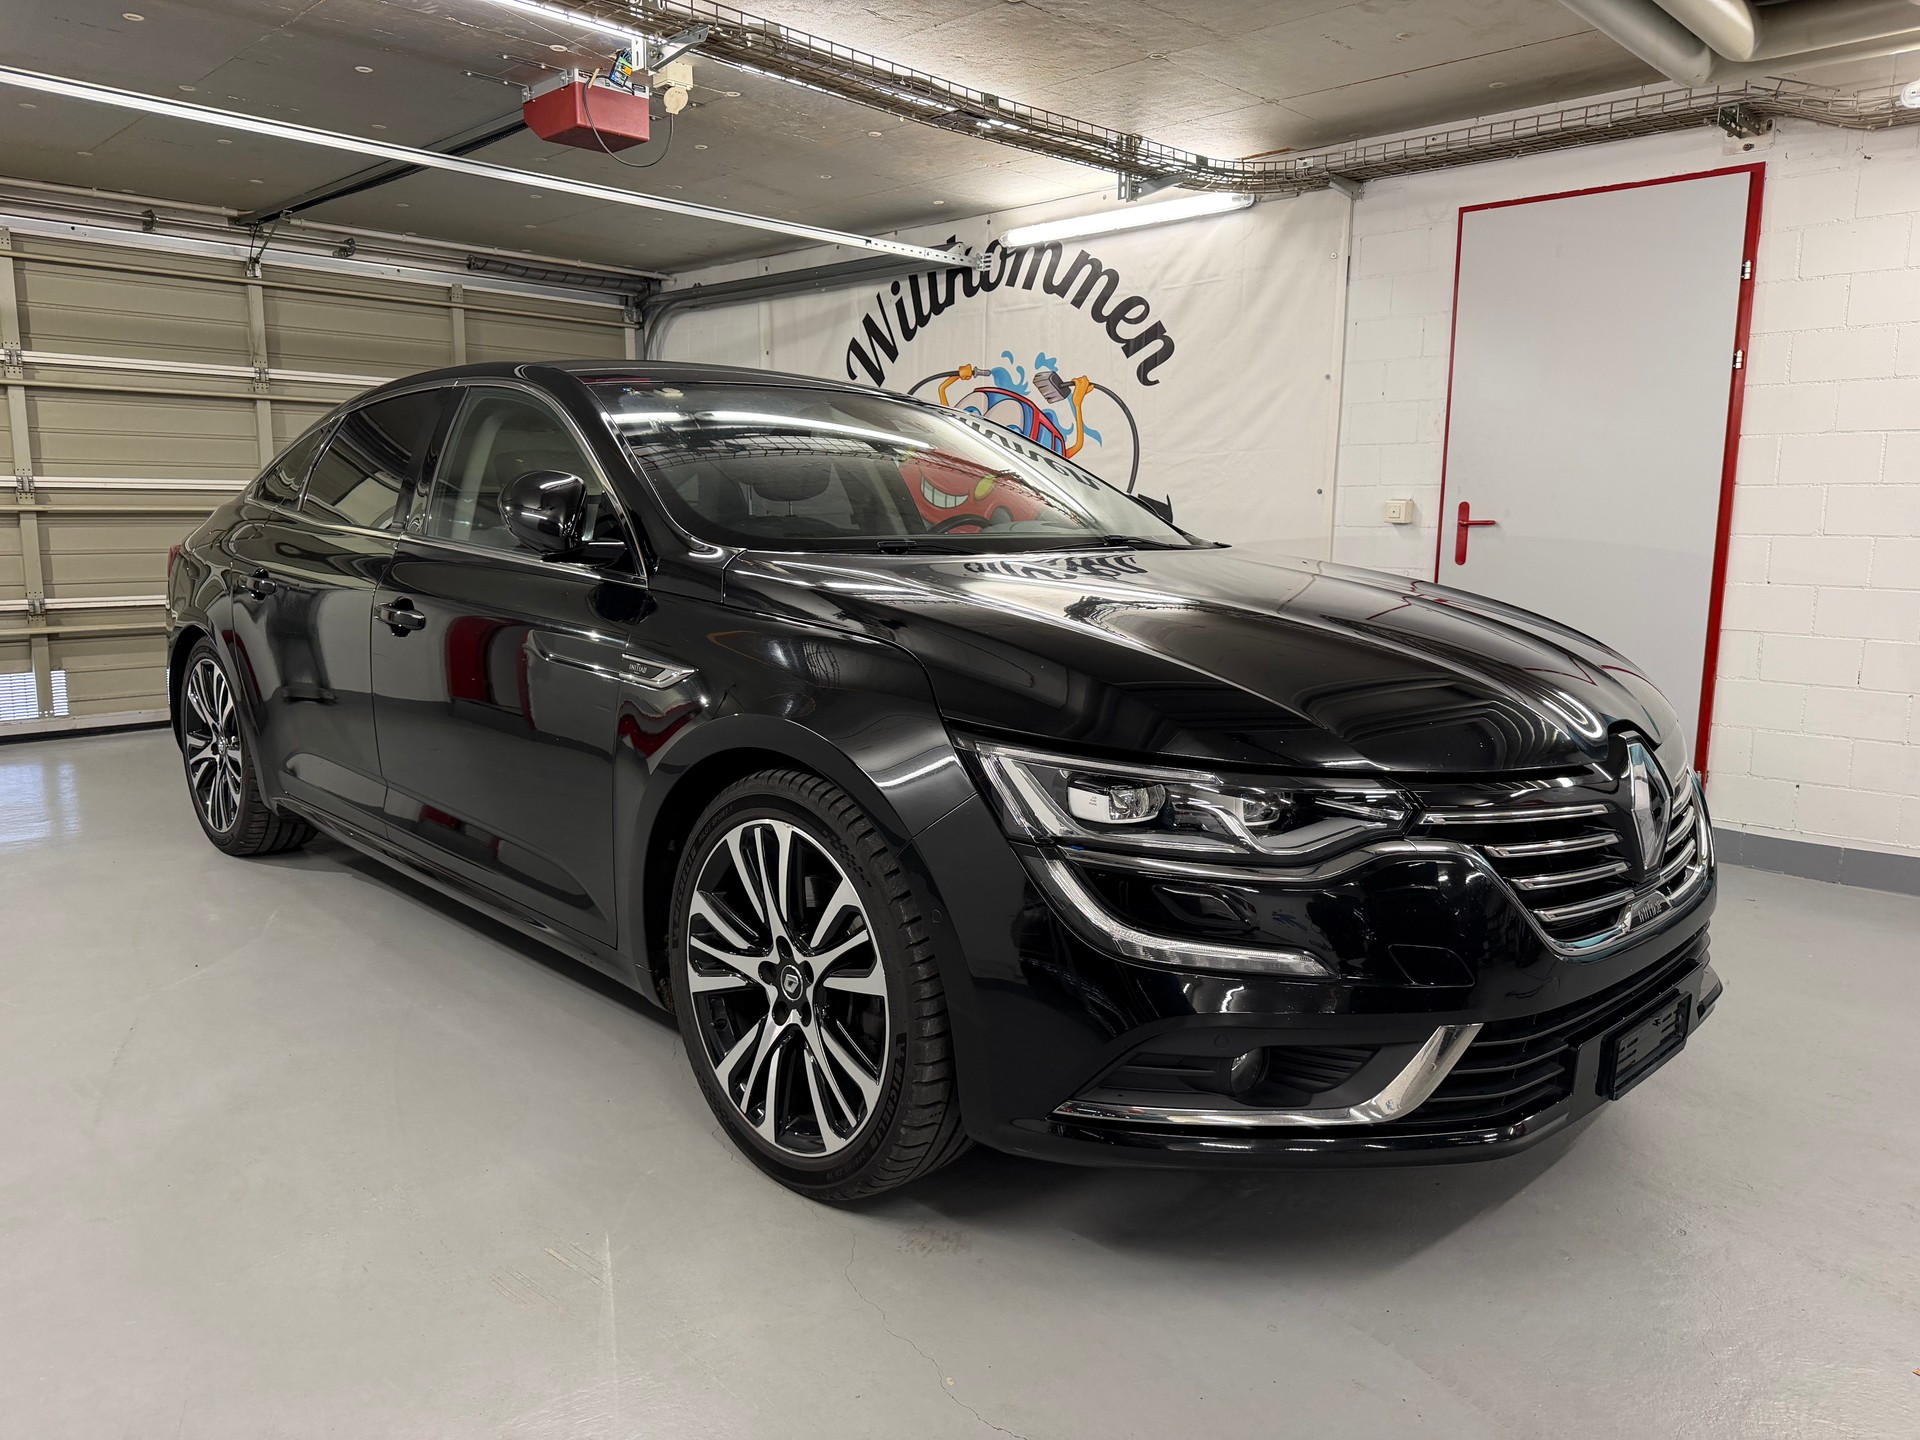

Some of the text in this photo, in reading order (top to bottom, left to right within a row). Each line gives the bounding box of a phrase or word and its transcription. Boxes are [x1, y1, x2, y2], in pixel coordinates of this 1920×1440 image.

[846, 234, 1175, 388] Willkommen
[673, 844, 698, 924] MICHELIN
[869, 1060, 903, 1149] MICHELIN
